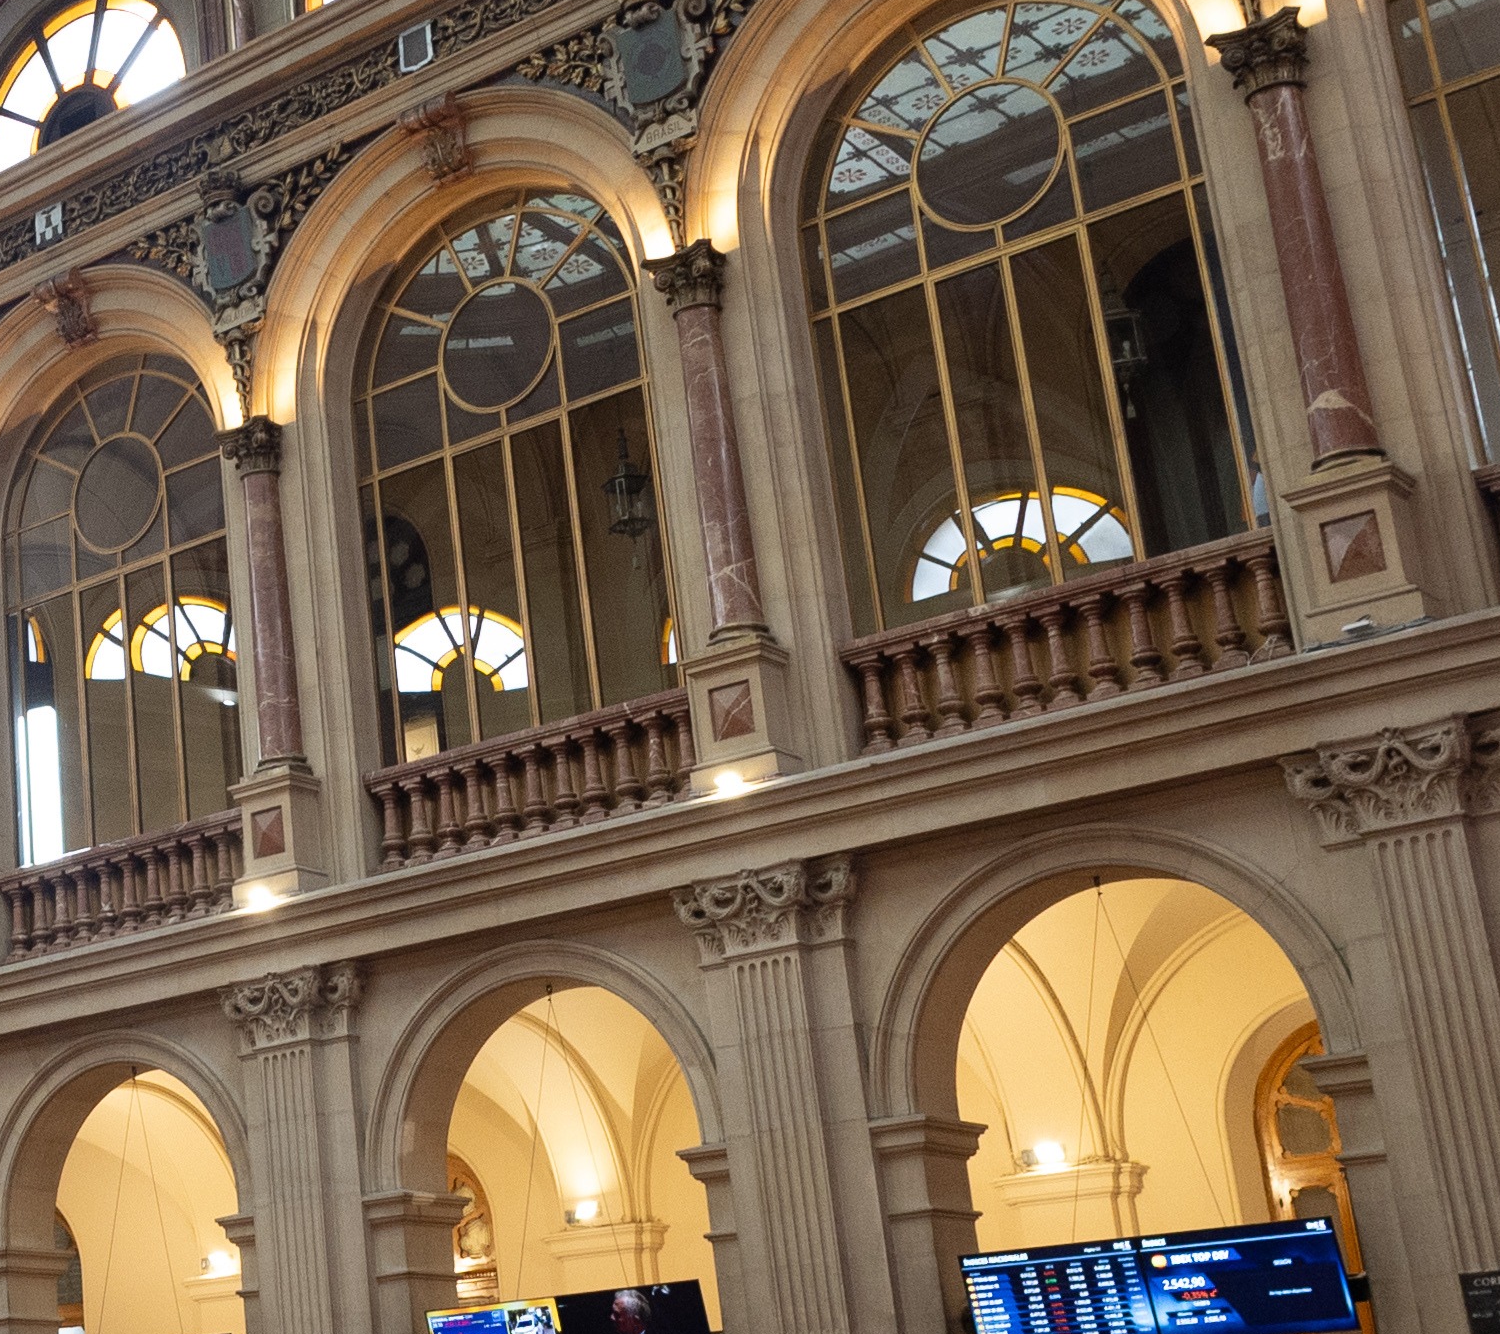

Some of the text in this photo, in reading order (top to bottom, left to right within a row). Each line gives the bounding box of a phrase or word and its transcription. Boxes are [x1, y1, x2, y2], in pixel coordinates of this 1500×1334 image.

[645, 120, 685, 145] BRASIL
[1192, 1251, 1211, 1263] TOP
[1162, 1276, 1205, 1291] 2.542,90
